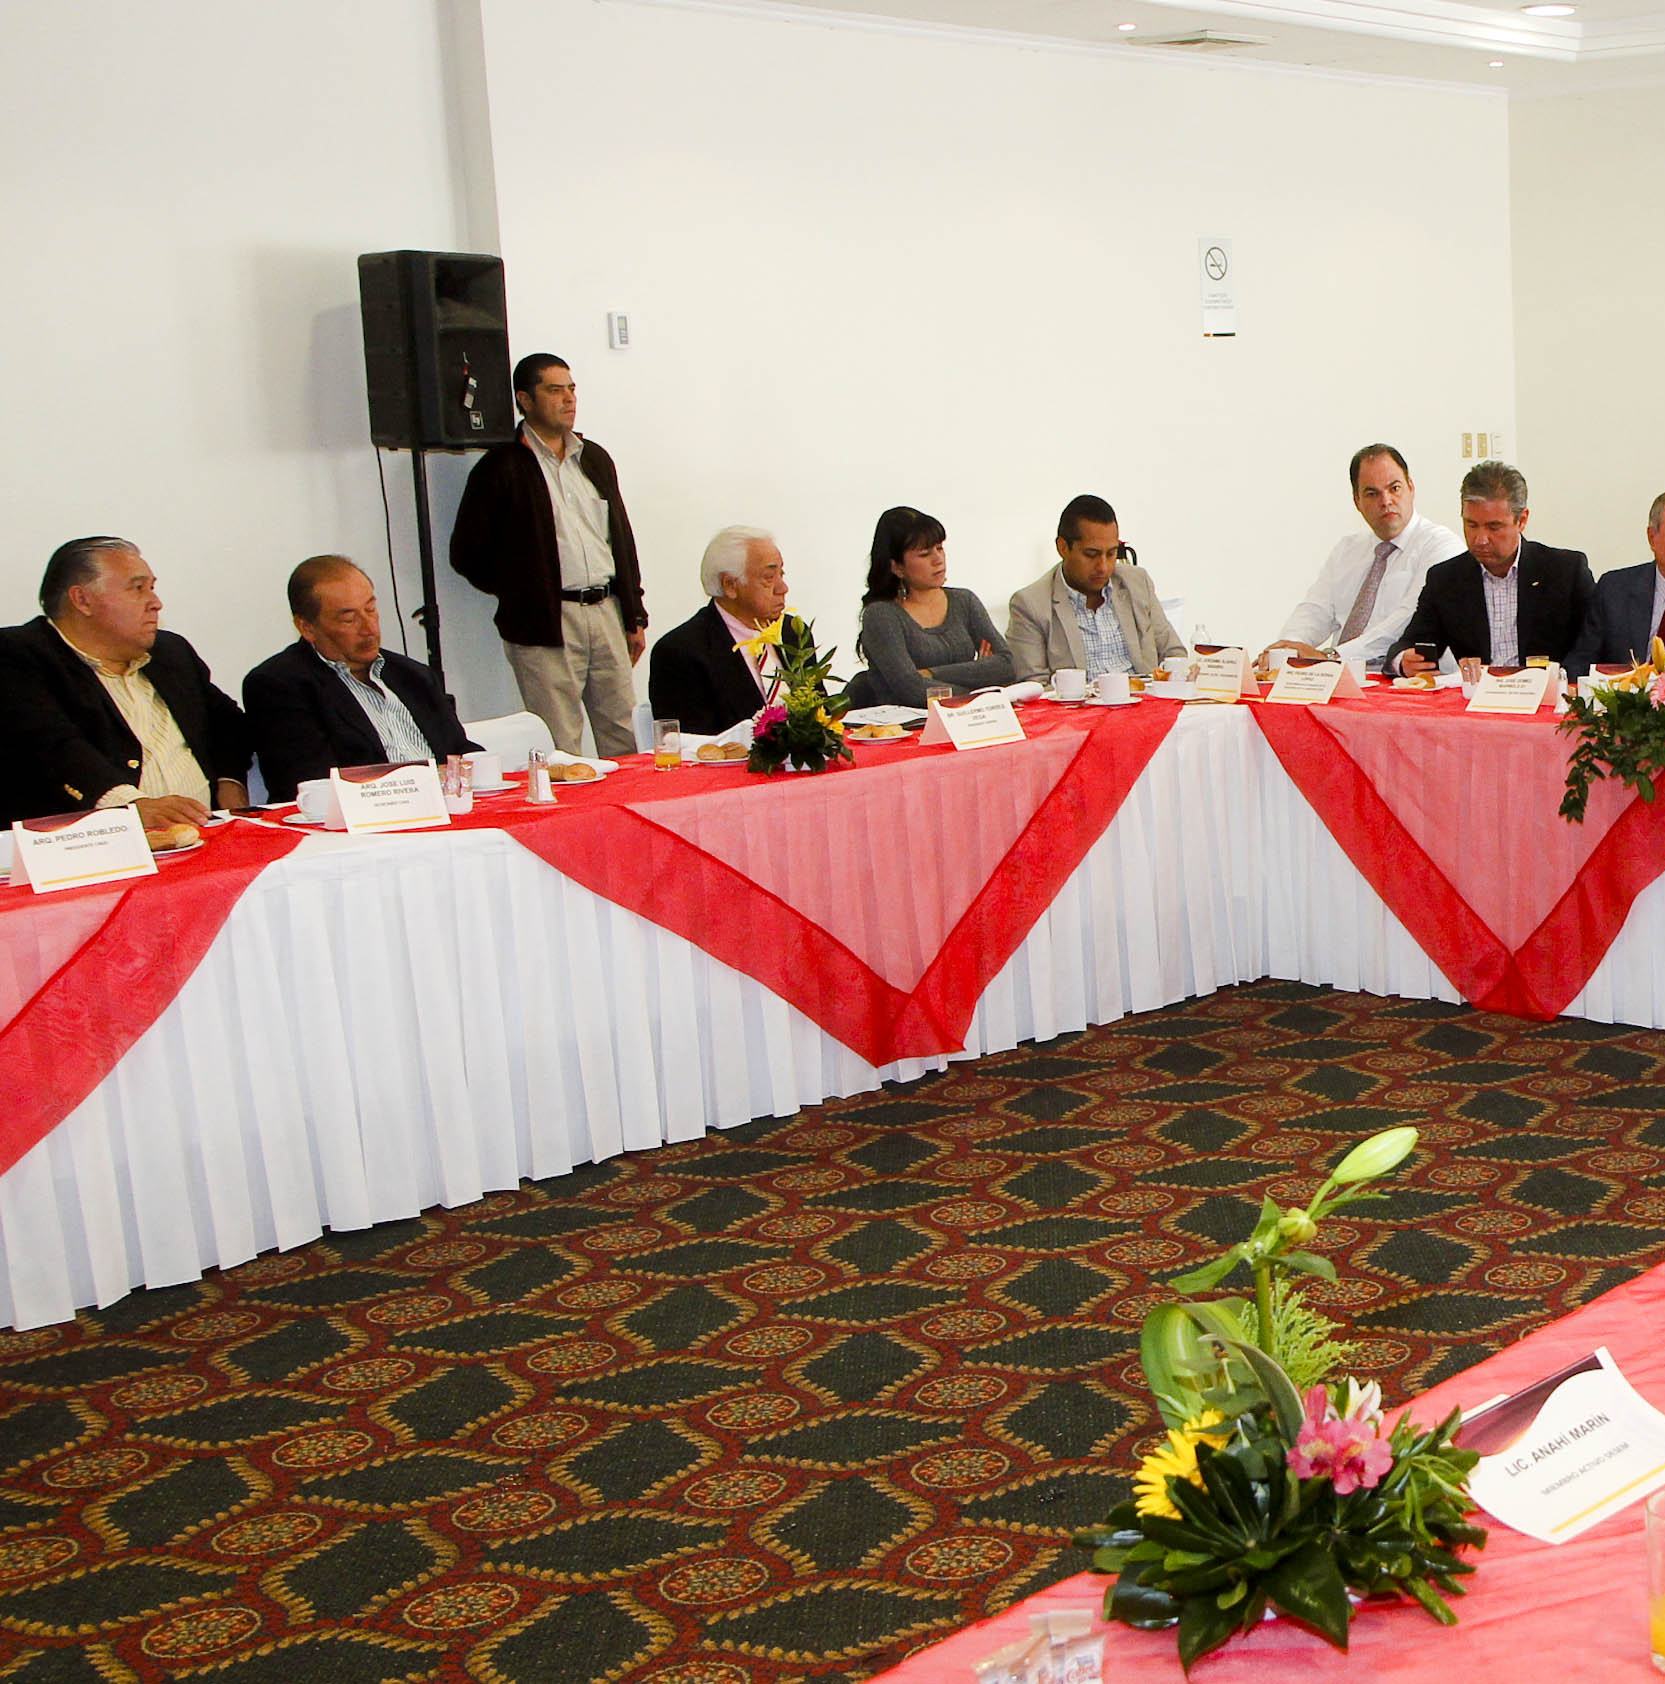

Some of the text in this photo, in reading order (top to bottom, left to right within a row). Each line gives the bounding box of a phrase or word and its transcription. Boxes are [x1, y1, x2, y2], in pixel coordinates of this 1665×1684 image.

[399, 778, 416, 786] LUIS
[360, 786, 420, 798] ROMERO RIVERA
[54, 831, 86, 842] PEDRO
[86, 825, 128, 838] ROBLEDO
[1505, 1458, 1534, 1477] LIC.
